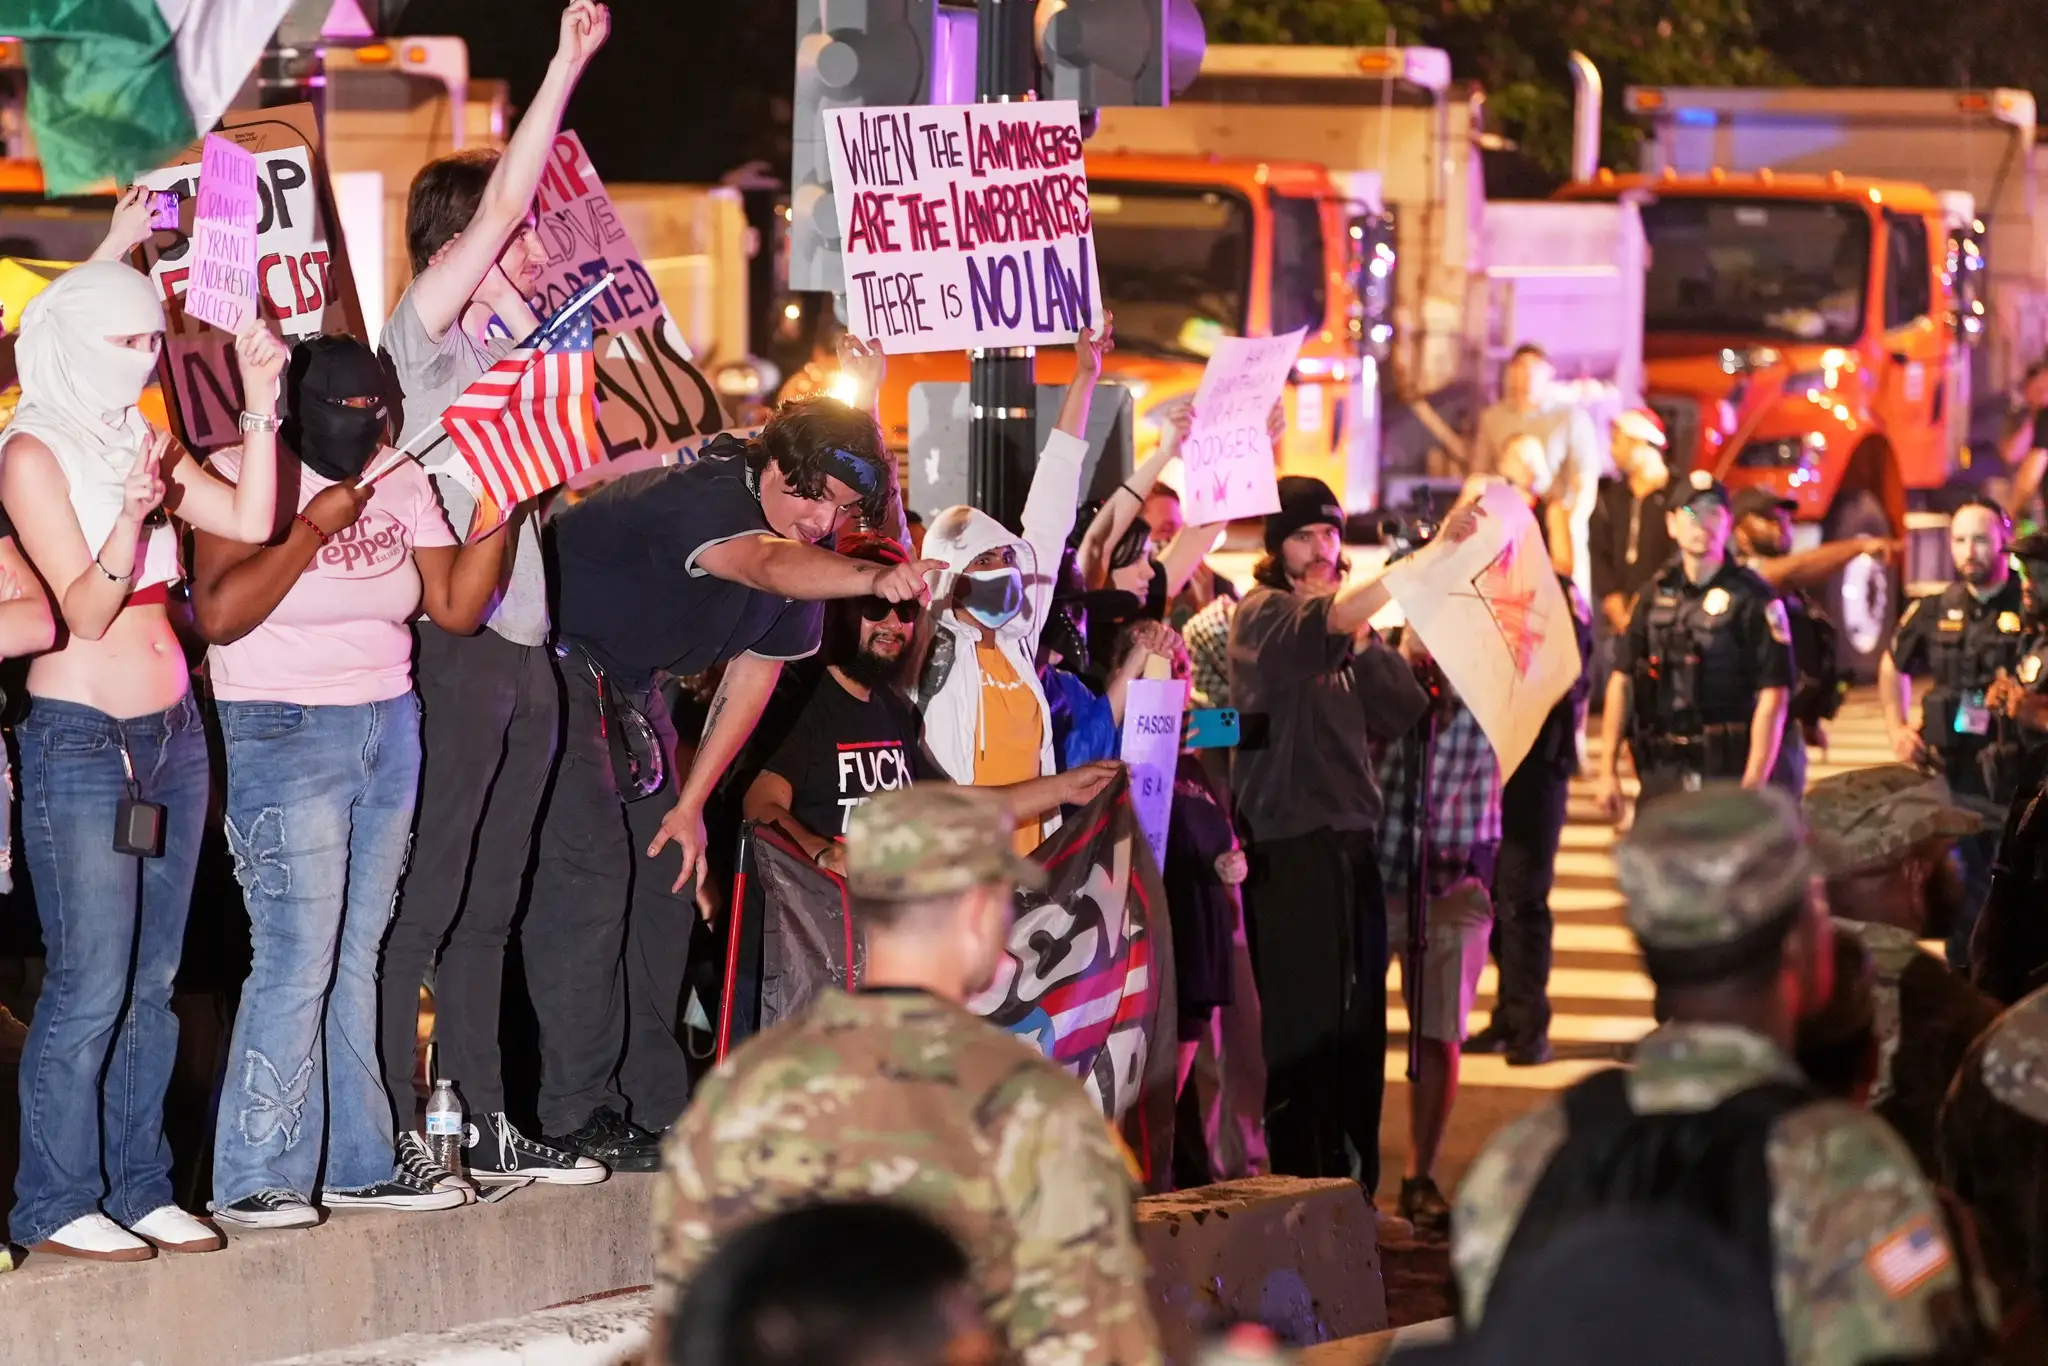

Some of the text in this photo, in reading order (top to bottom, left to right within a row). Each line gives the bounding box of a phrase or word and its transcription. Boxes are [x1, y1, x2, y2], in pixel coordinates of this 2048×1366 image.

[836, 111, 1082, 186] WHEN THE LAWMAKERS
[200, 185, 249, 229] ORANGE
[847, 173, 1091, 254] ARE THE LAWBREAKERS
[195, 224, 250, 265] TYRANT
[187, 287, 243, 331] SOCIETY
[852, 237, 1092, 337] THERE IS NO LAW
[1191, 425, 1260, 472] DODGER
[838, 749, 913, 792] FUCK
[1142, 776, 1152, 797] IS
